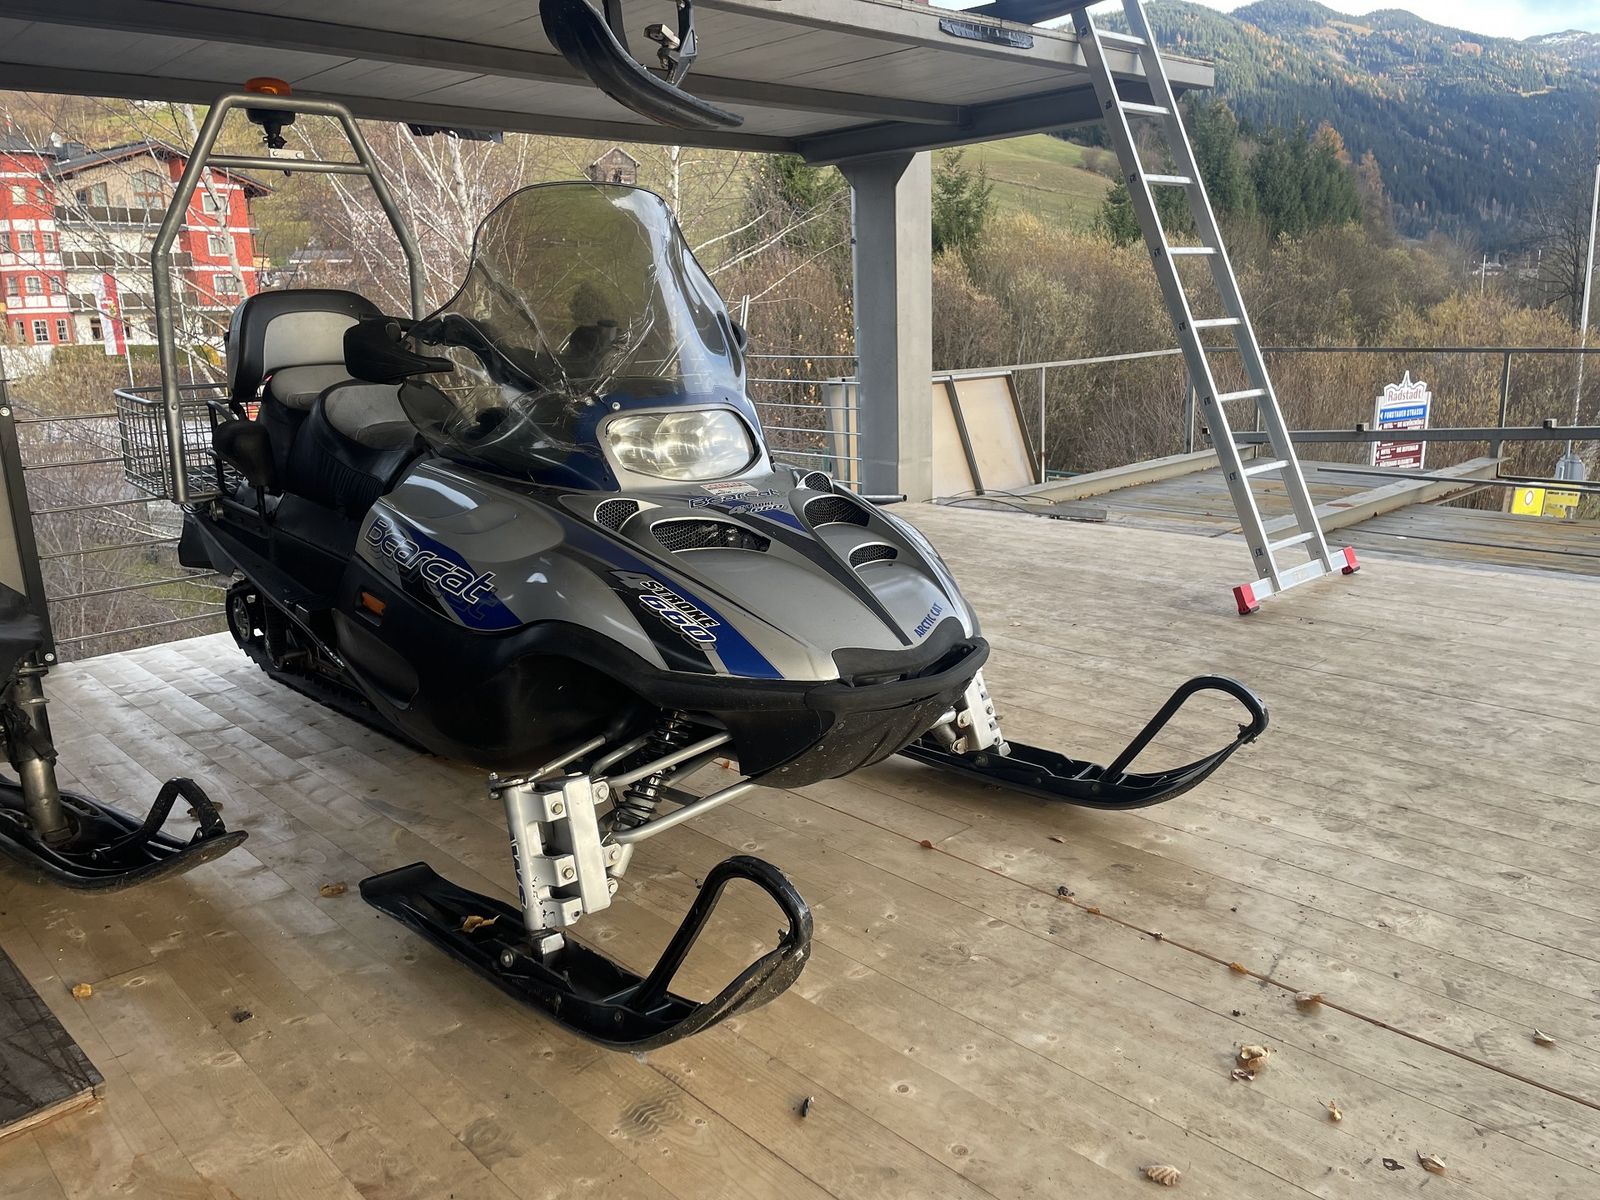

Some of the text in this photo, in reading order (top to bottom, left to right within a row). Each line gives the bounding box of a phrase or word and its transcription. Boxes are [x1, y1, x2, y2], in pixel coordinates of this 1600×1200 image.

[1388, 389, 1421, 401] Radstadt
[688, 488, 780, 509] Bearcat
[364, 513, 496, 604] Bearcat
[638, 594, 717, 642] 660
[640, 579, 721, 628] STROKE
[914, 602, 943, 638] ARCTIC CAT
